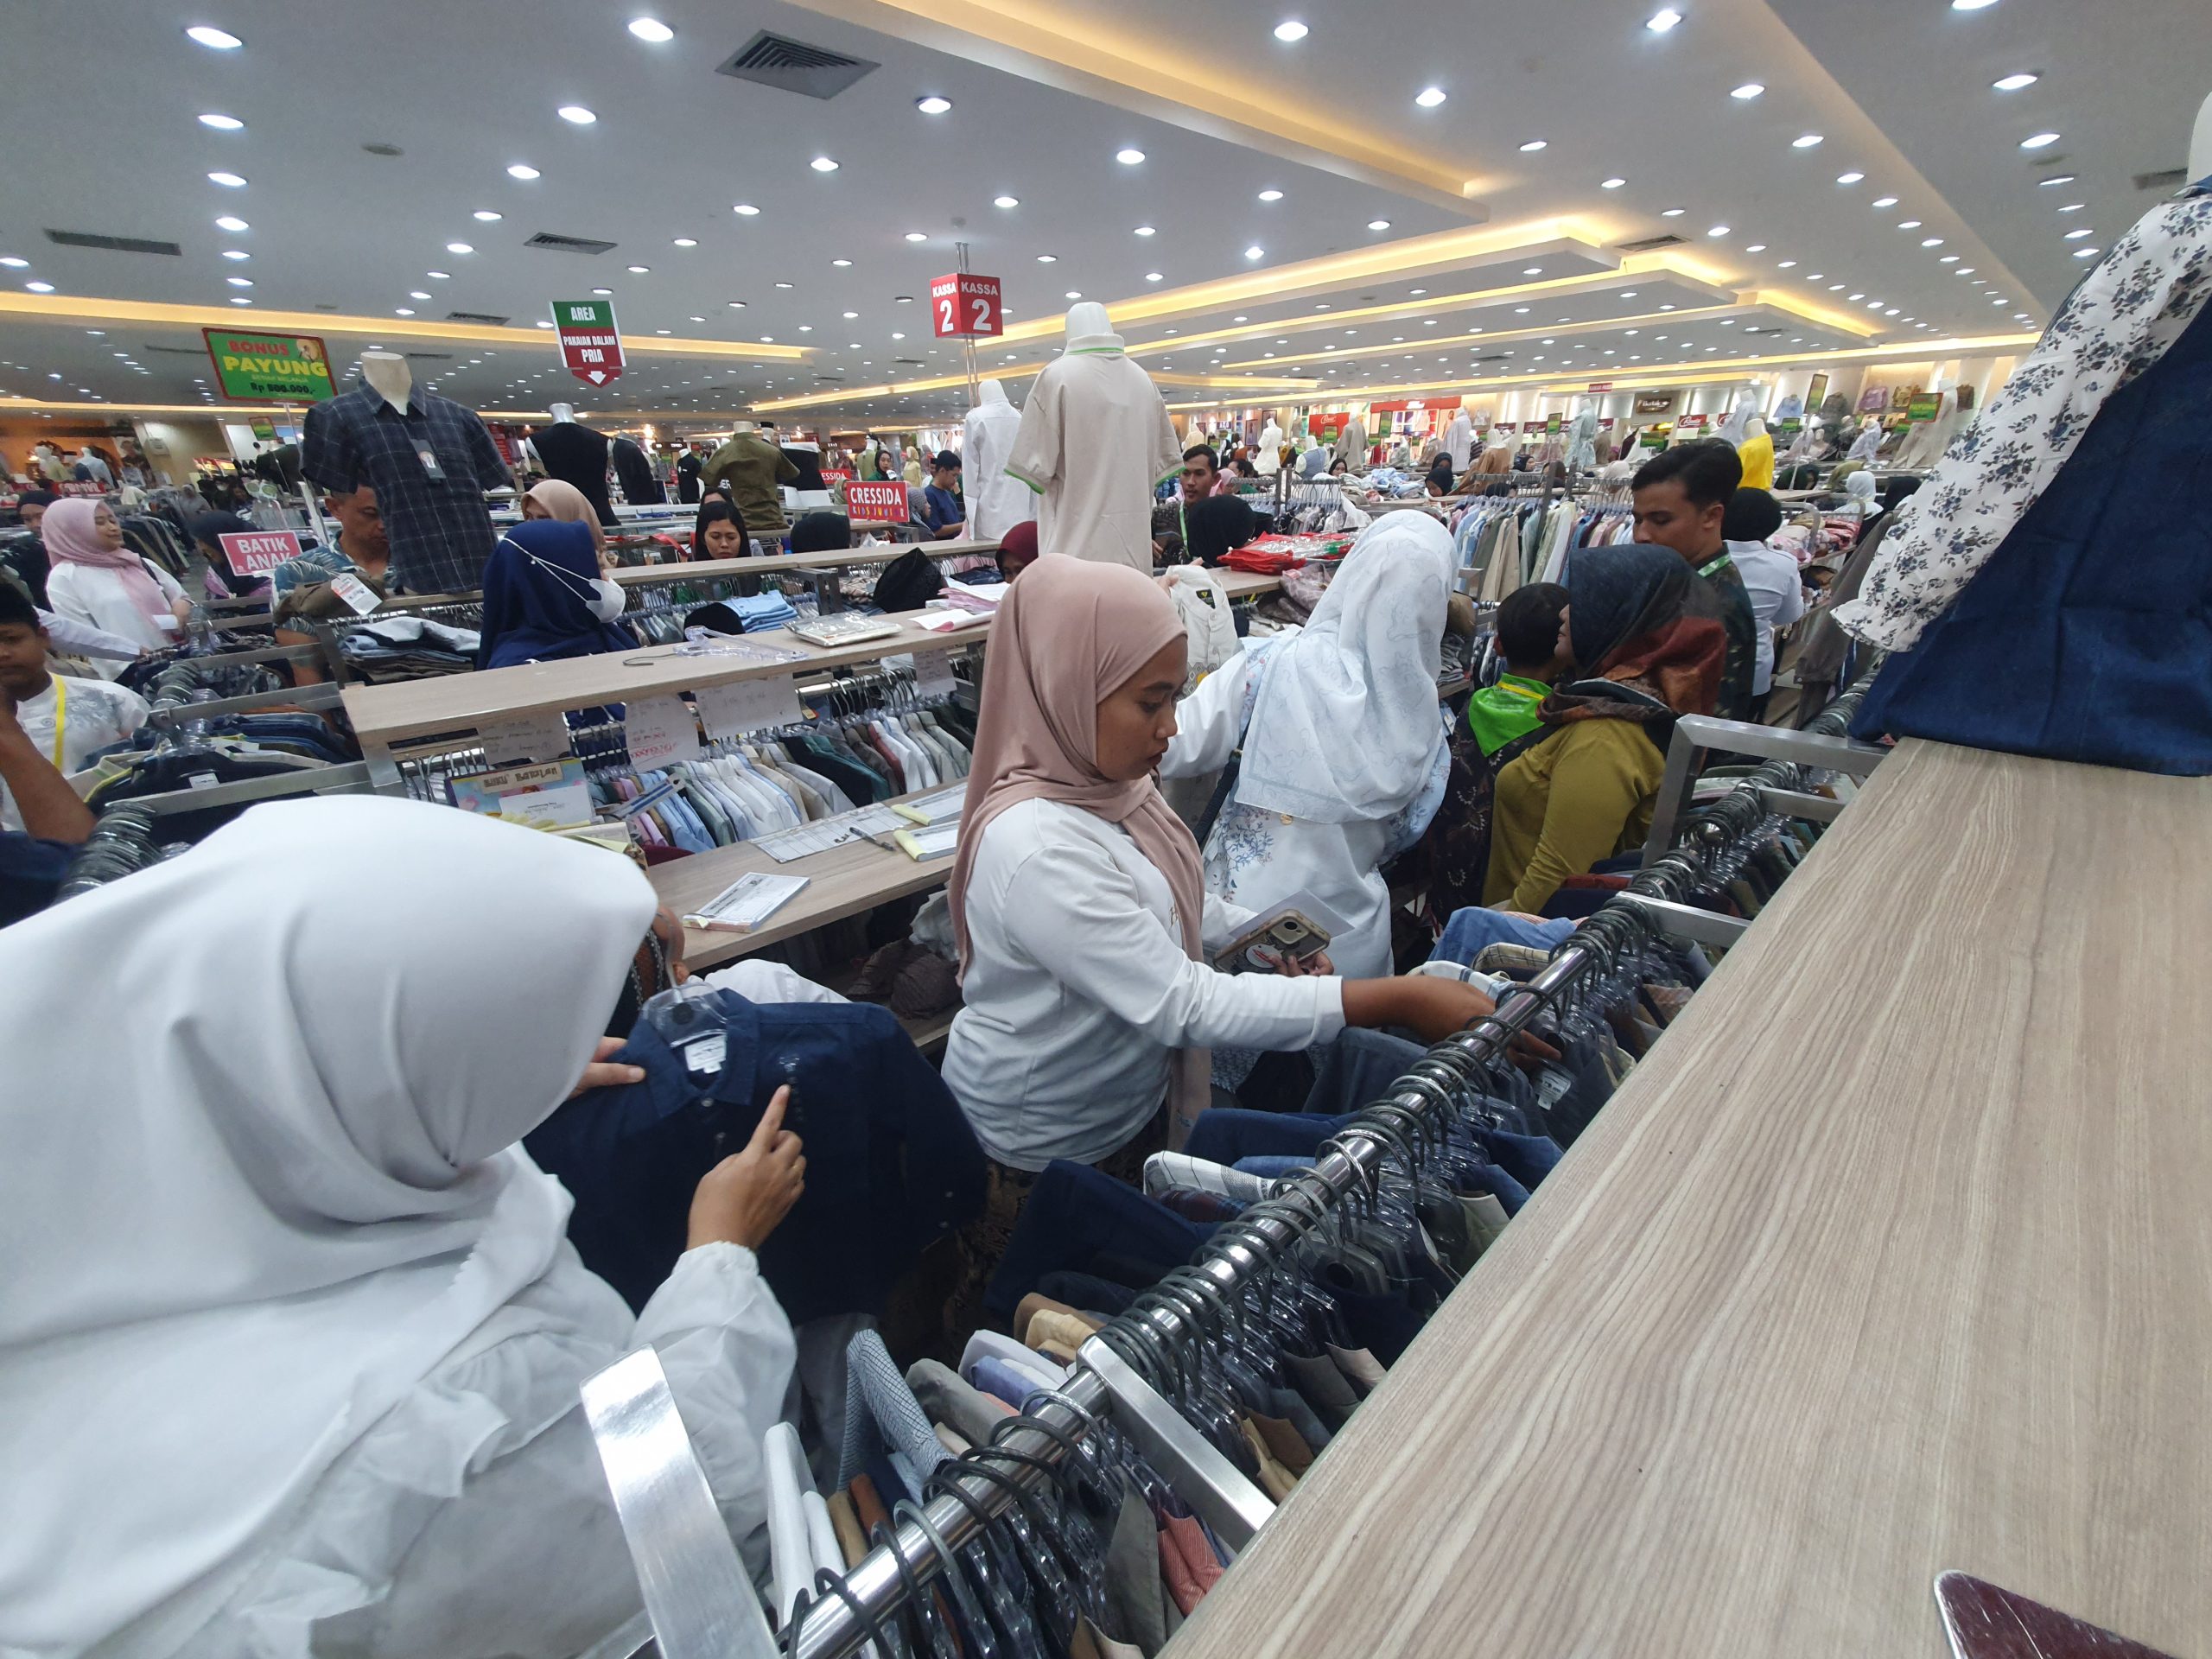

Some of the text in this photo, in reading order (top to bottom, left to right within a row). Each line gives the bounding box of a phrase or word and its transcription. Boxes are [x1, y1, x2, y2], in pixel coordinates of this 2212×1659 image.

[932, 282, 957, 298] KASSA
[961, 281, 998, 296] KASSA
[570, 307, 596, 321] AREA
[939, 299, 954, 333] 2
[971, 298, 992, 331] 2
[227, 340, 289, 356] BONUS
[563, 335, 616, 346] PAKAIAN DALAM
[581, 349, 604, 363] PRIA
[223, 355, 328, 377] PAYUNG
[821, 472, 847, 480] ESSIDA
[850, 487, 903, 505] CRESSIDA
[852, 505, 871, 516] KIDS
[237, 537, 290, 554] BATIK
[246, 552, 290, 570] ANAK
